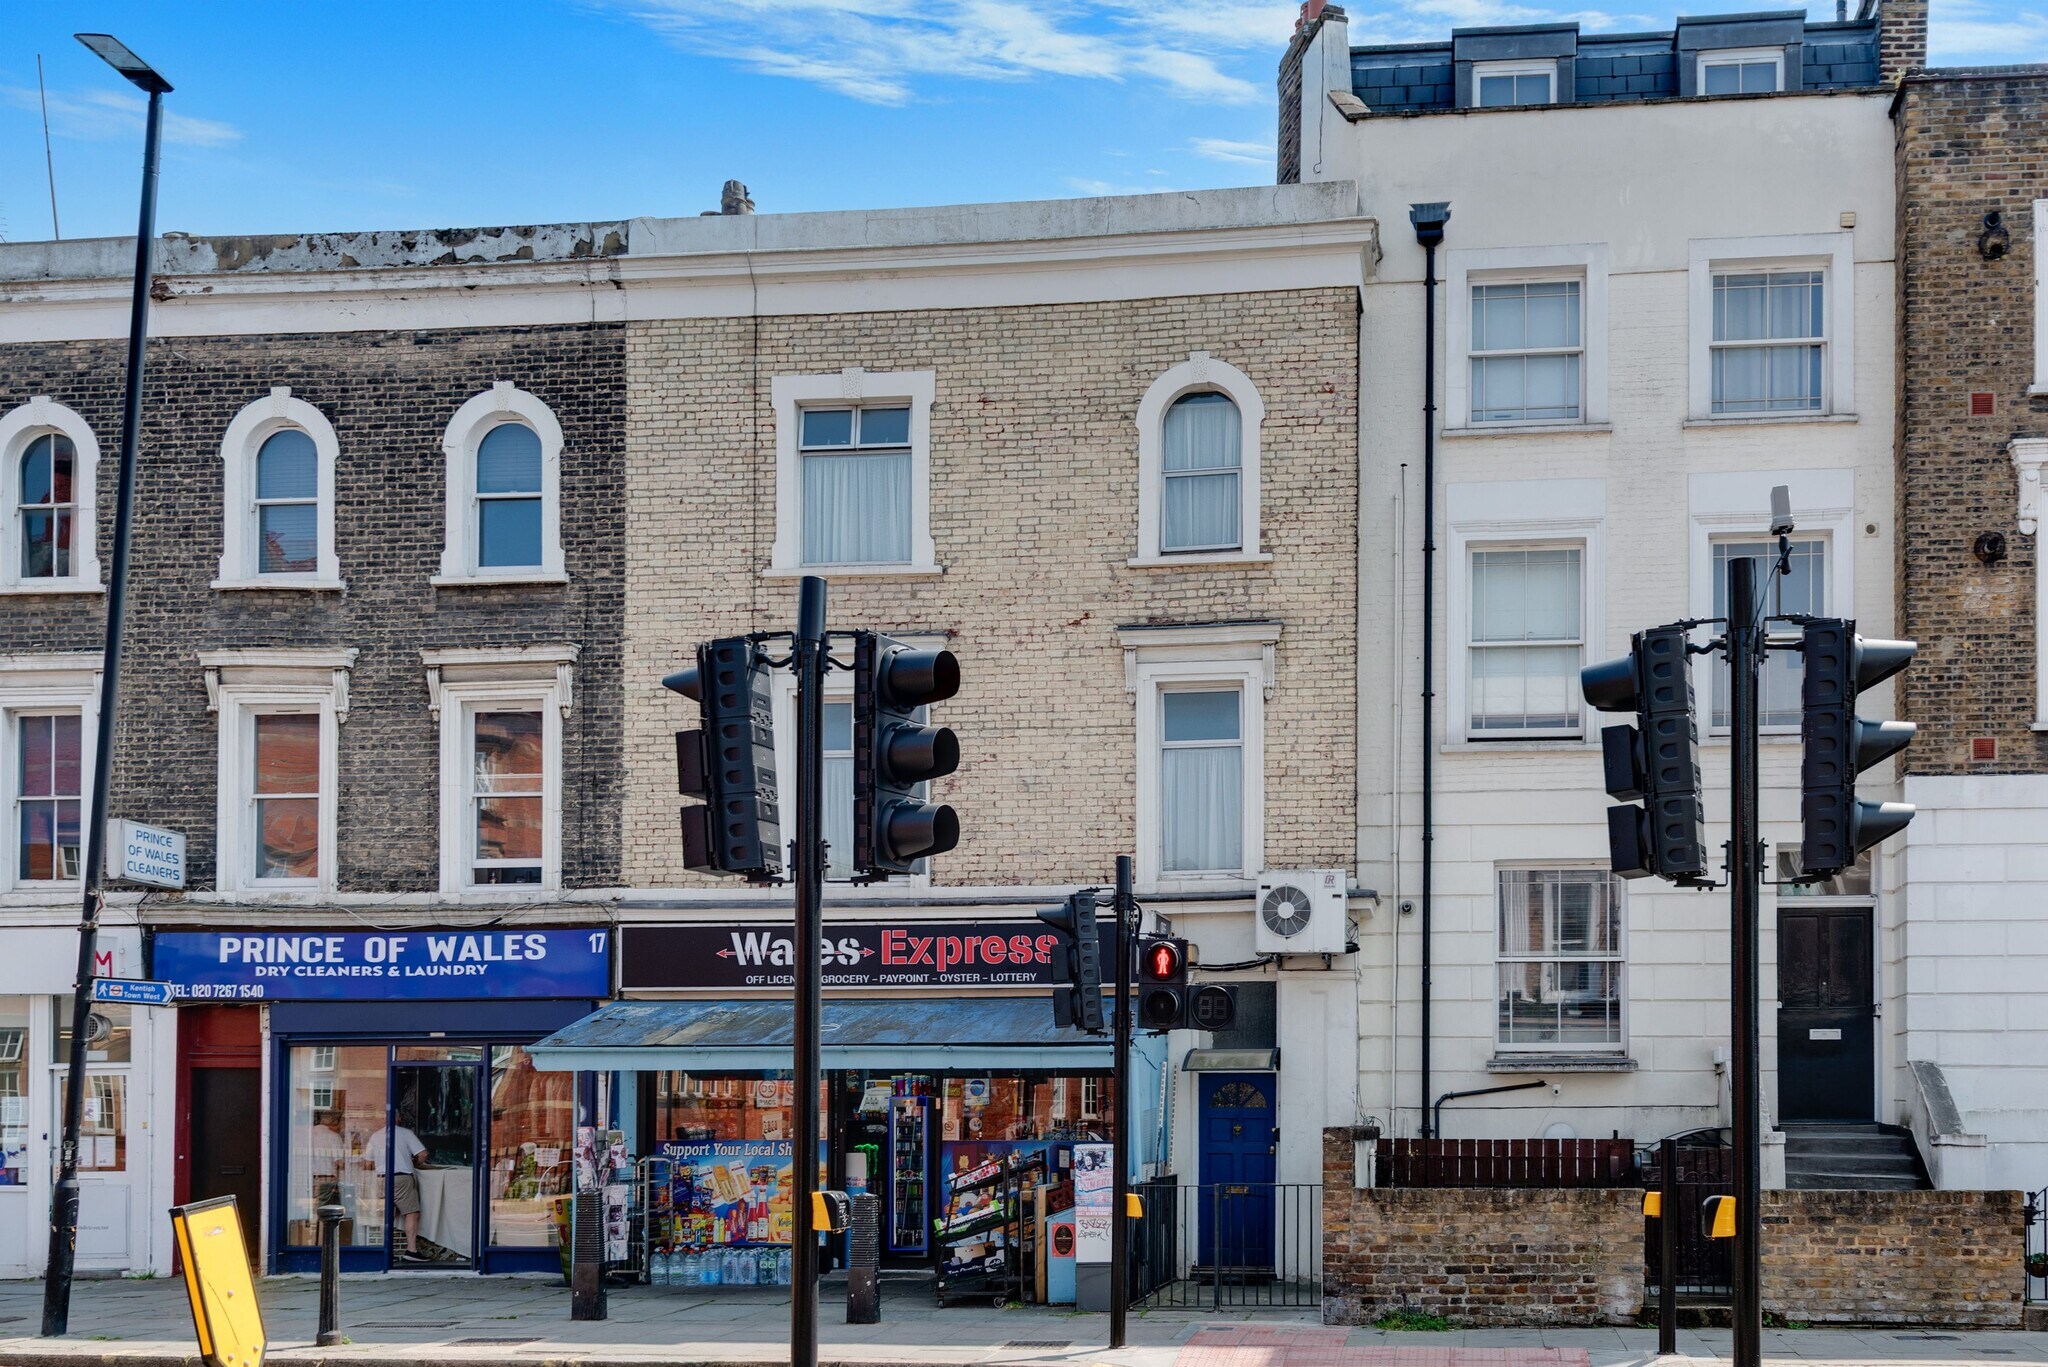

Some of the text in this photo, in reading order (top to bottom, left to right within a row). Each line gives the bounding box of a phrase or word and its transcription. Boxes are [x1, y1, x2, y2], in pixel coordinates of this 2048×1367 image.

[136, 830, 173, 847] PRINCE
[128, 845, 179, 864] OF WALES
[127, 861, 180, 880] CLEANERS
[219, 934, 547, 963] PRINCE OF WALES
[588, 932, 606, 953] 17
[730, 929, 1059, 972] Waes Express
[255, 964, 489, 977] DRY CLEANERS & LAUNDRY
[746, 975, 765, 984] OFF
[768, 975, 796, 984] LICEN
[821, 974, 870, 984] GROCERY
[879, 974, 930, 983] PAYPOINT
[939, 973, 980, 983] OYSTER
[990, 972, 1037, 982] LOTTERY
[129, 984, 156, 992] Kentish
[172, 984, 264, 998] TEL: 020 7267 1540
[663, 1143, 793, 1160] Support Your Local Sh
